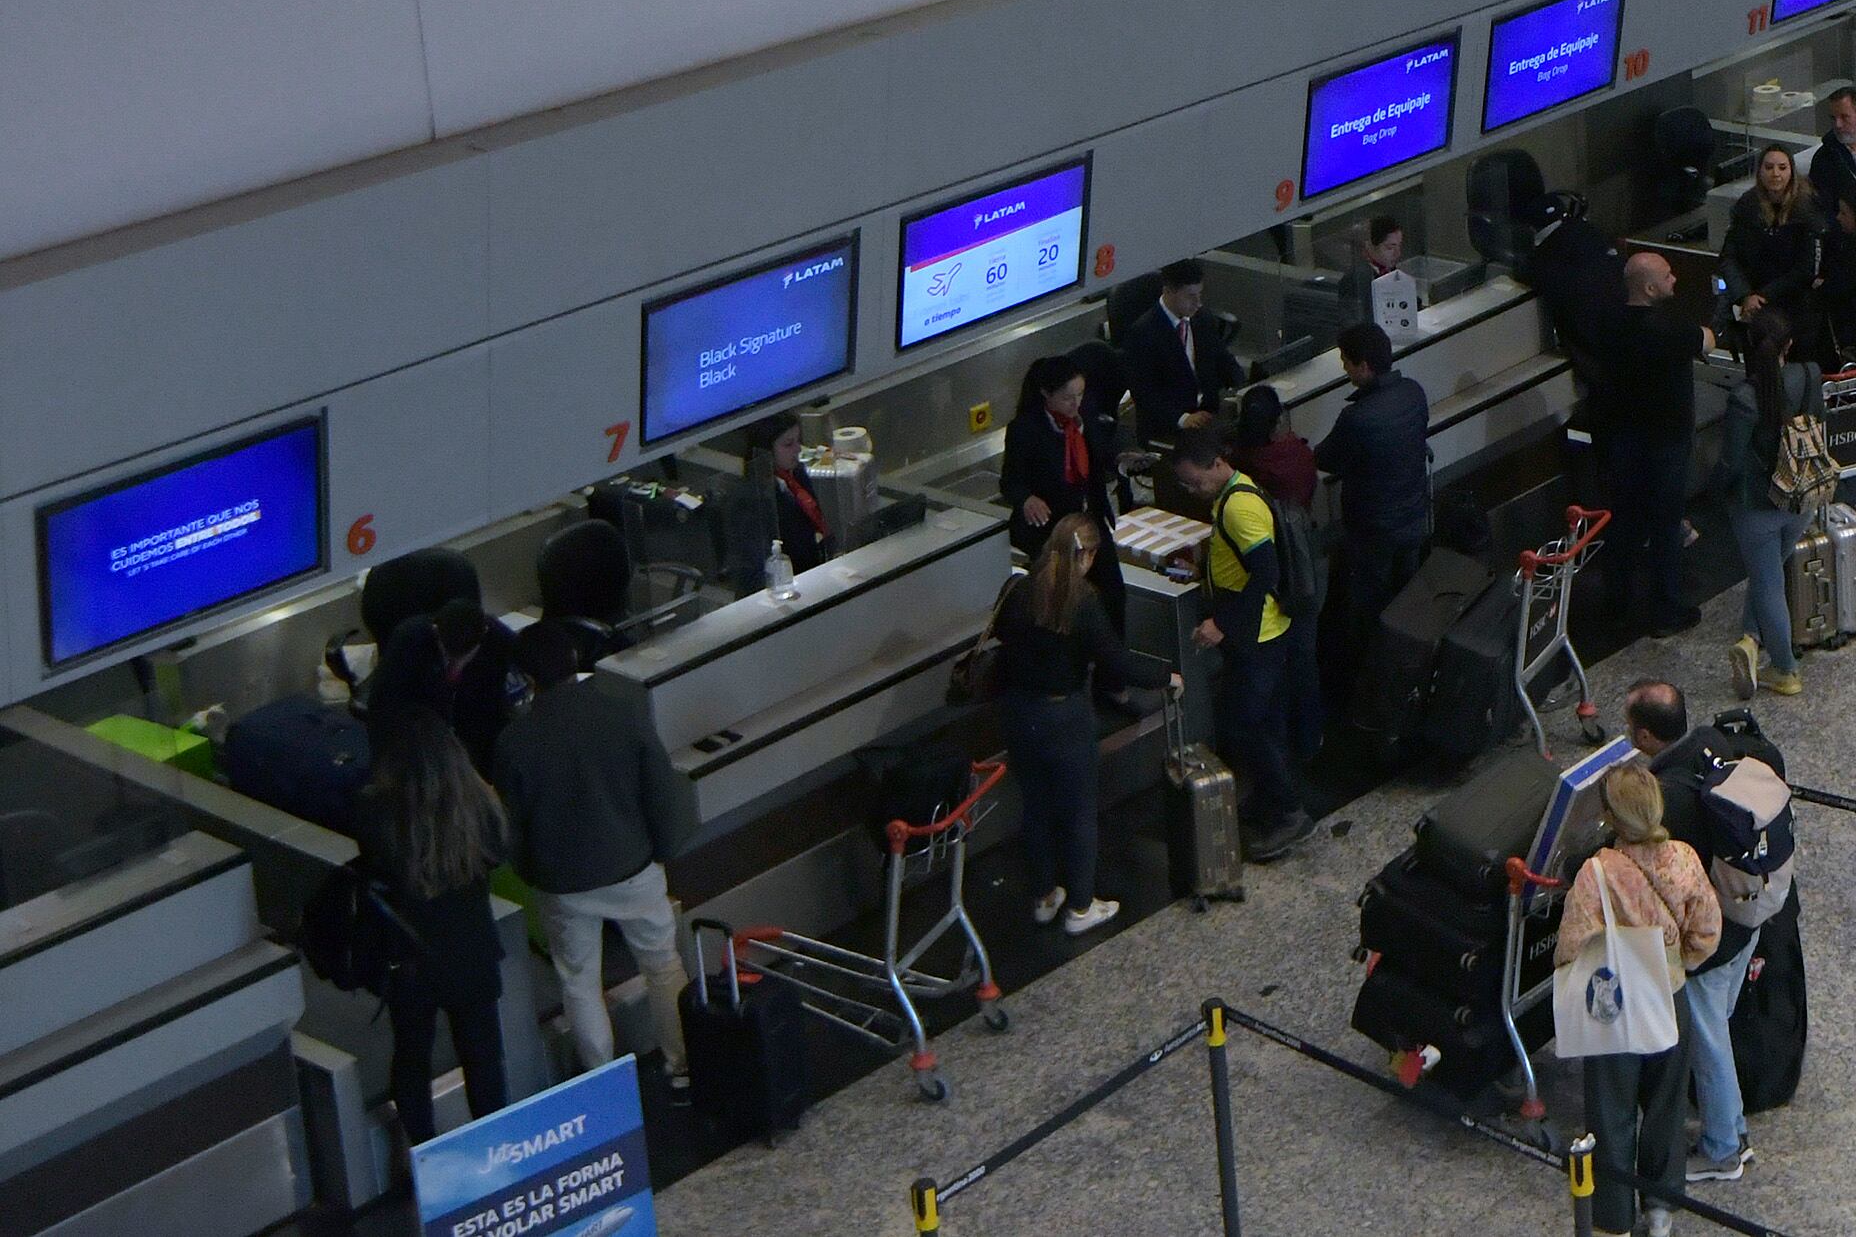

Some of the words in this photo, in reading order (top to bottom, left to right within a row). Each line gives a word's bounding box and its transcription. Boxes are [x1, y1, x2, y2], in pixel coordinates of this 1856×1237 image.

[1747, 5, 1768, 35] 11
[1413, 48, 1449, 69] LATAM
[1508, 52, 1546, 76] Entrega
[1546, 46, 1559, 61] de
[1559, 32, 1599, 59] Equipaje
[1623, 48, 1650, 81] 10
[1537, 67, 1551, 83] Bag
[1551, 62, 1569, 78] Drop
[1330, 114, 1371, 140] Entrega
[1372, 106, 1386, 122] de
[1387, 90, 1431, 119] Equipaje
[1362, 128, 1377, 145] Bag
[1378, 124, 1397, 141] Drop
[984, 201, 1026, 223] LATAM
[1275, 179, 1295, 213] 9
[795, 257, 844, 282] LATAM
[1037, 244, 1059, 266] 20
[1094, 243, 1116, 278] 8
[986, 262, 1008, 284] 60
[931, 306, 962, 323] tiempo
[700, 343, 737, 368] Black
[740, 321, 802, 356] Signature
[700, 363, 737, 389] Black
[604, 420, 631, 463] 7
[111, 545, 128, 560] ES
[130, 518, 206, 552] IMPORTANTE
[207, 508, 233, 525] QUE
[234, 498, 260, 514] NOS
[346, 513, 377, 556] 6
[111, 541, 175, 572] CUIDEMOS
[175, 527, 213, 549] ENTRE
[453, 1208, 500, 1237] ESTA
[503, 1194, 526, 1218] ES
[528, 1183, 554, 1206] LA
[557, 1151, 625, 1194] FORMA
[492, 1207, 556, 1237] VOLAR
[558, 1169, 625, 1215] SMART
